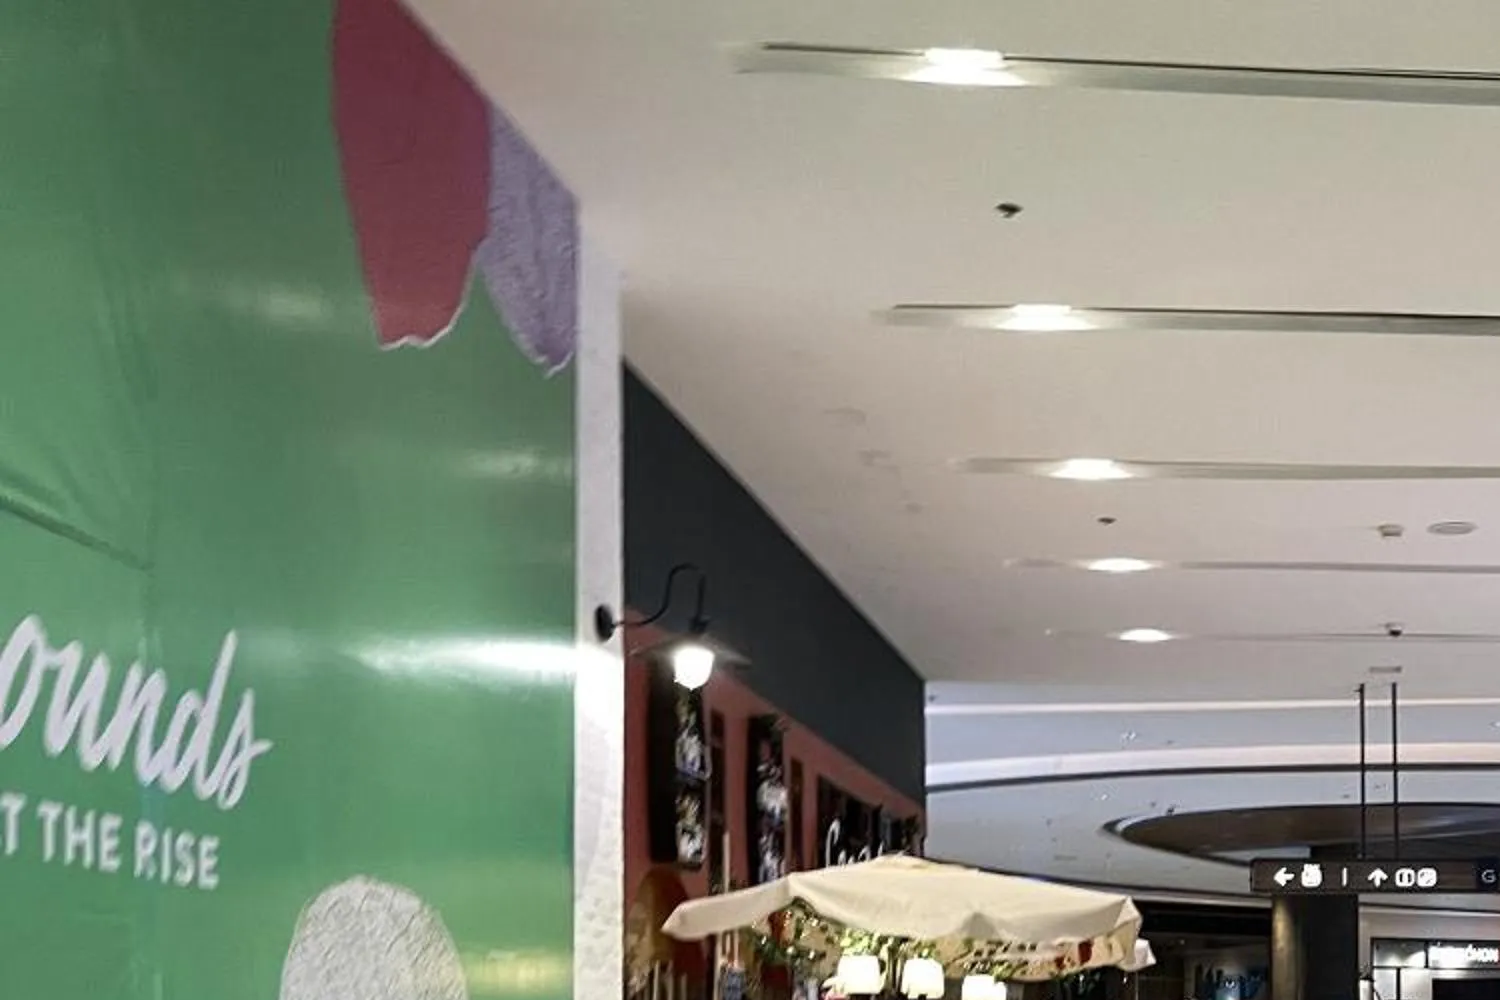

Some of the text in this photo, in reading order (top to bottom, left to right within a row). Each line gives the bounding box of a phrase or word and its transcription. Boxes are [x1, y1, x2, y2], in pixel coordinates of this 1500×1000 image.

[37, 798, 123, 873] THE
[134, 820, 221, 890] RISE
[1481, 869, 1497, 883] G
